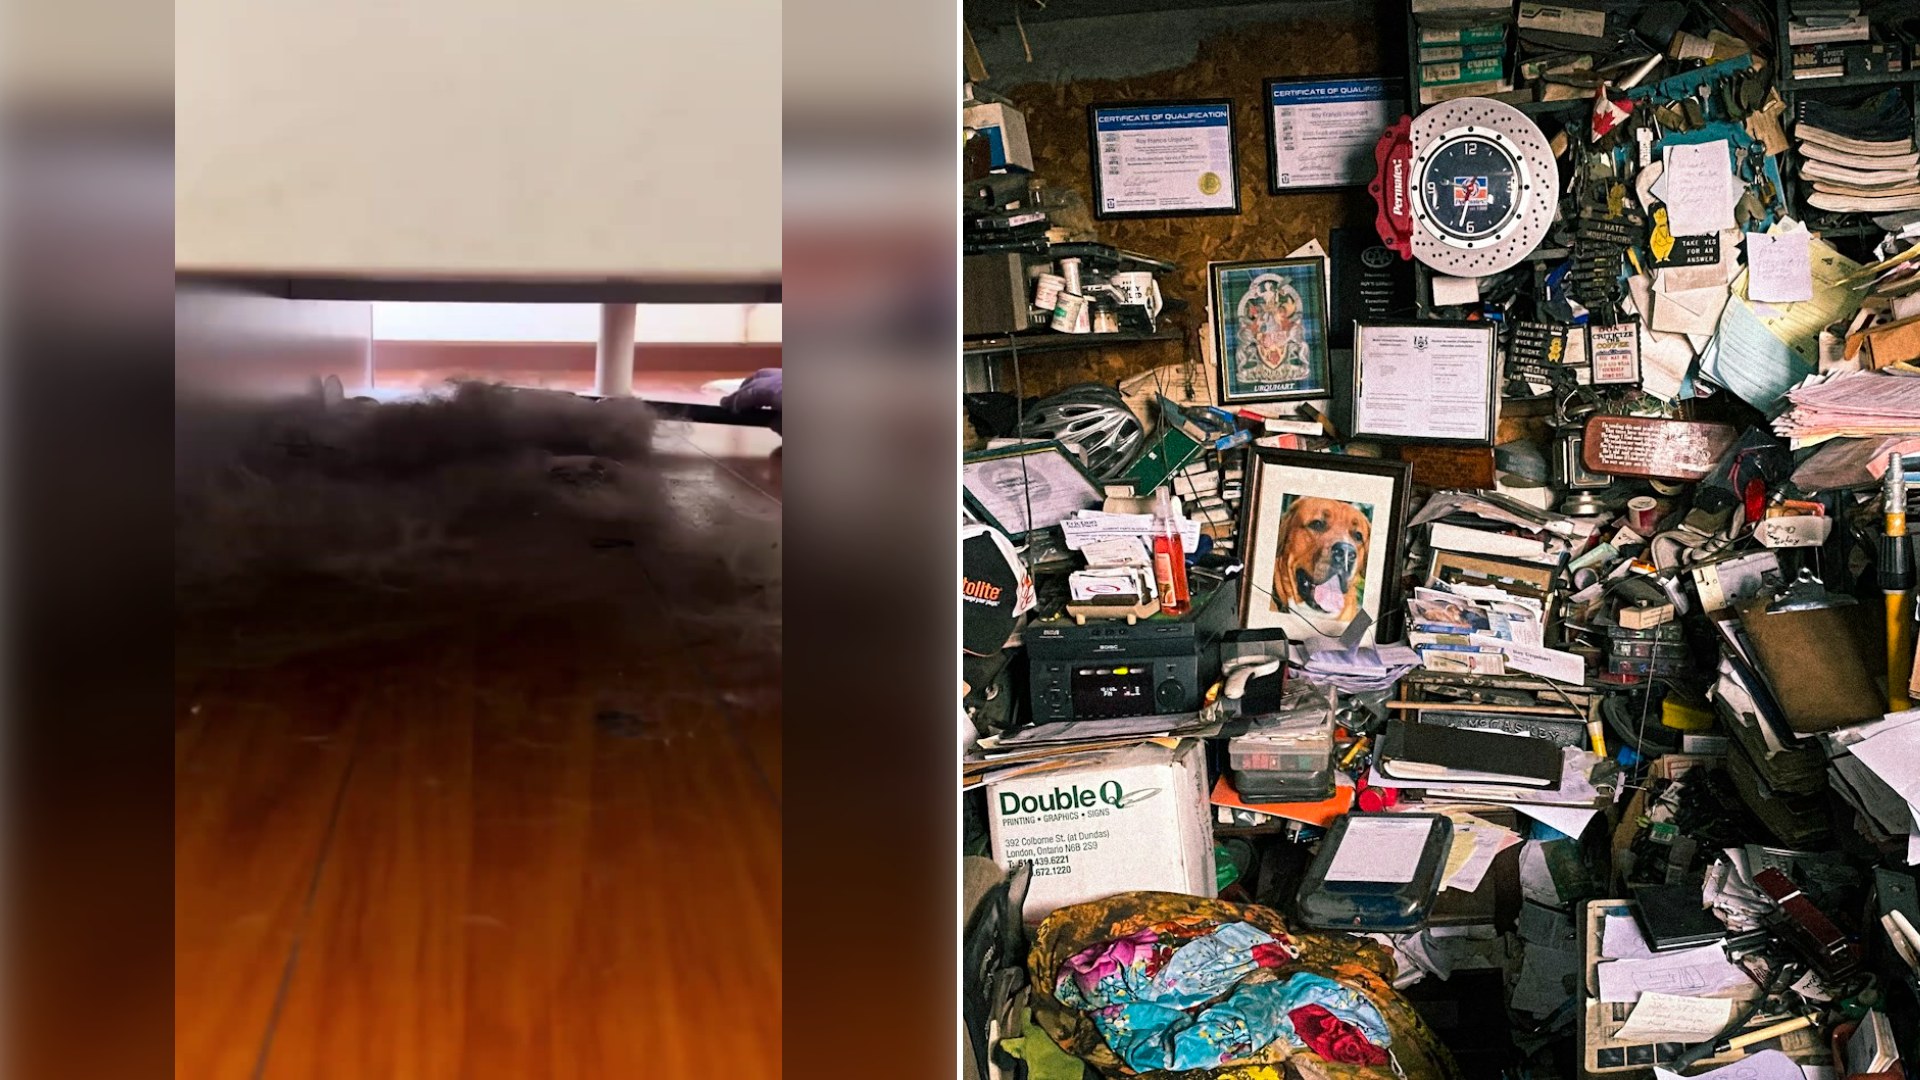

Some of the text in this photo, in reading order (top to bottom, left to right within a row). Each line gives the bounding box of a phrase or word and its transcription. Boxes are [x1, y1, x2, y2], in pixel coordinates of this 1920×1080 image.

[1273, 88, 1326, 97] CERTIFICATE
[1327, 87, 1339, 95] OF
[1340, 85, 1384, 94] QUALIFICA
[1098, 114, 1150, 123] CERTIFICATE
[1151, 113, 1164, 121] OF
[1165, 111, 1227, 120] QUALIFICATION
[1464, 143, 1477, 155] 12
[1393, 159, 1403, 216] Permatex
[1427, 181, 1436, 194] 9
[1466, 221, 1475, 233] 6
[1604, 223, 1625, 232] HATE
[1520, 321, 1533, 329] THE
[1535, 323, 1548, 331] MAN
[1598, 325, 1629, 333] DON'T
[1592, 331, 1634, 340] CRITICIZE
[1596, 341, 1630, 349] COFFEE
[1254, 383, 1295, 392] URQUHART
[999, 780, 1125, 816] Double Q
[1002, 808, 1110, 827] PRINTING GRAPHICS SIGNS
[1005, 829, 1110, 848] 392 Colborne St. (at Dundas)
[1006, 841, 1098, 858] London, Ontario N6B 2S9
[1008, 860, 1015, 869] T:
